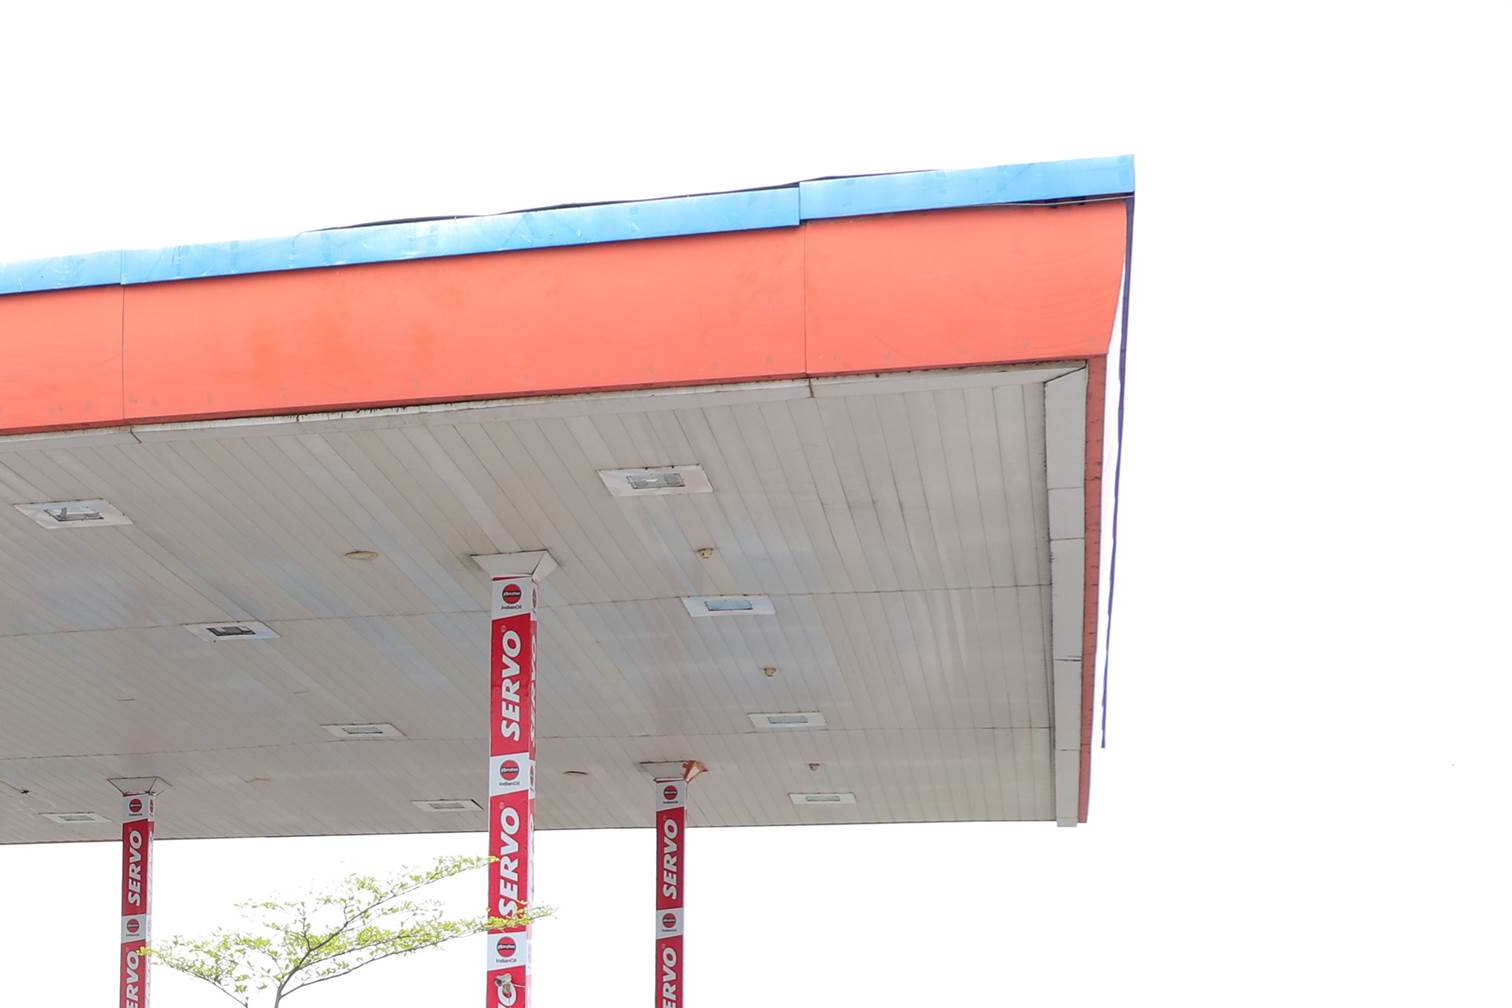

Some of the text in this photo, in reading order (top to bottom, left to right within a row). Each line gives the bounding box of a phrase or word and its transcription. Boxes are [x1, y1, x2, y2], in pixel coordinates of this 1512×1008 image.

[501, 630, 521, 742] SERVO
[128, 830, 143, 906] SERVO
[499, 806, 520, 920] SERVO
[663, 818, 678, 900] SERVO
